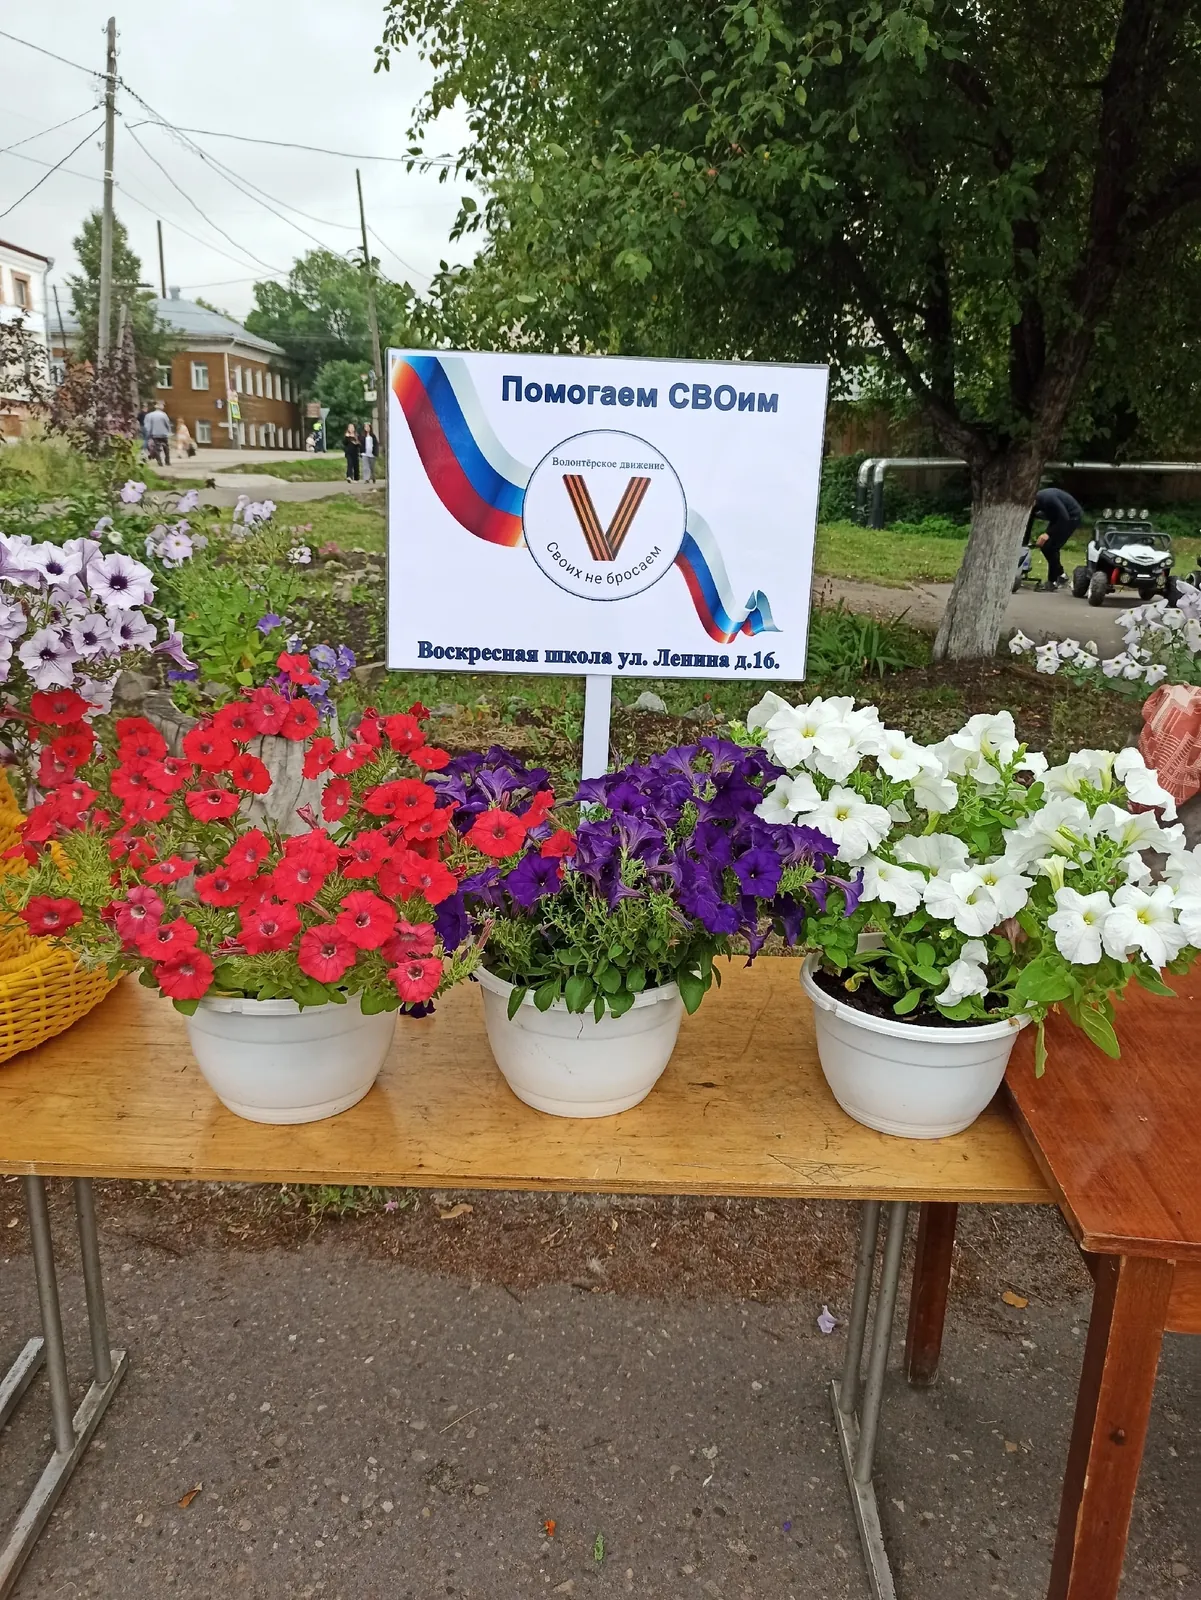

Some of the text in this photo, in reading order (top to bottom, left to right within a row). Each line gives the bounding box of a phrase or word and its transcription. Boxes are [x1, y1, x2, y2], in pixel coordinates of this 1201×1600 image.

[502, 375, 779, 413] Помогаем СВОим
[552, 457, 665, 470] Волонтёрское движение
[562, 474, 652, 562] V
[546, 541, 662, 585] Своих не бросаем
[417, 641, 780, 670] Воскресная школа ул. Ленина д.16.
